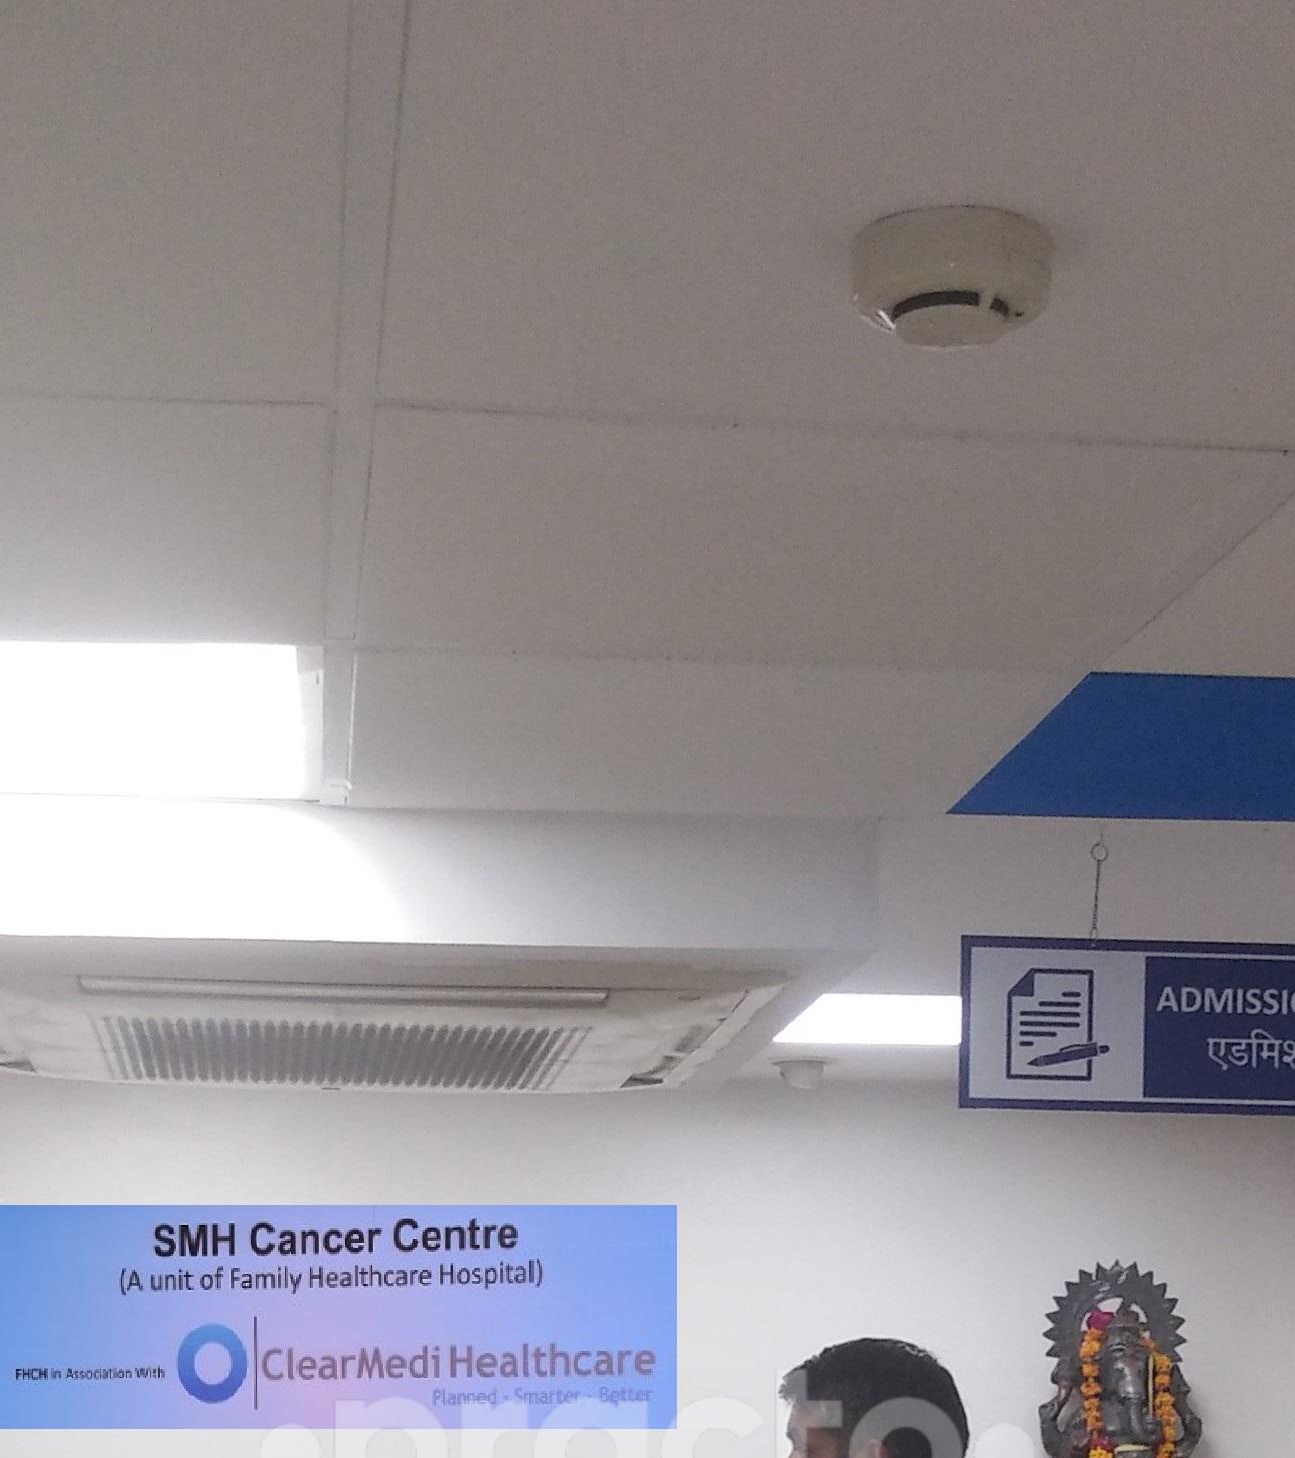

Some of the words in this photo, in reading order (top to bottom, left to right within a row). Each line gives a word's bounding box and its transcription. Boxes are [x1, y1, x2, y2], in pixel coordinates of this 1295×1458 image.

[154, 1222, 236, 1257] SMH
[250, 1222, 382, 1256] Cancer
[393, 1217, 520, 1252] Centre
[119, 1267, 144, 1296] (A
[150, 1267, 195, 1292] unit
[199, 1265, 224, 1291] of
[230, 1265, 303, 1295] Family
[309, 1263, 433, 1289] Healthcare
[439, 1258, 544, 1290] Hospital)
[15, 1367, 49, 1381] FHCH
[51, 1367, 62, 1379] in
[65, 1367, 133, 1381] Association
[134, 1366, 166, 1379] With
[261, 1345, 441, 1381] ClearMedi
[449, 1343, 656, 1379] Healthcare
[432, 1387, 498, 1406] Planned
[514, 1386, 581, 1405] Smarter
[598, 1385, 654, 1404] Better
